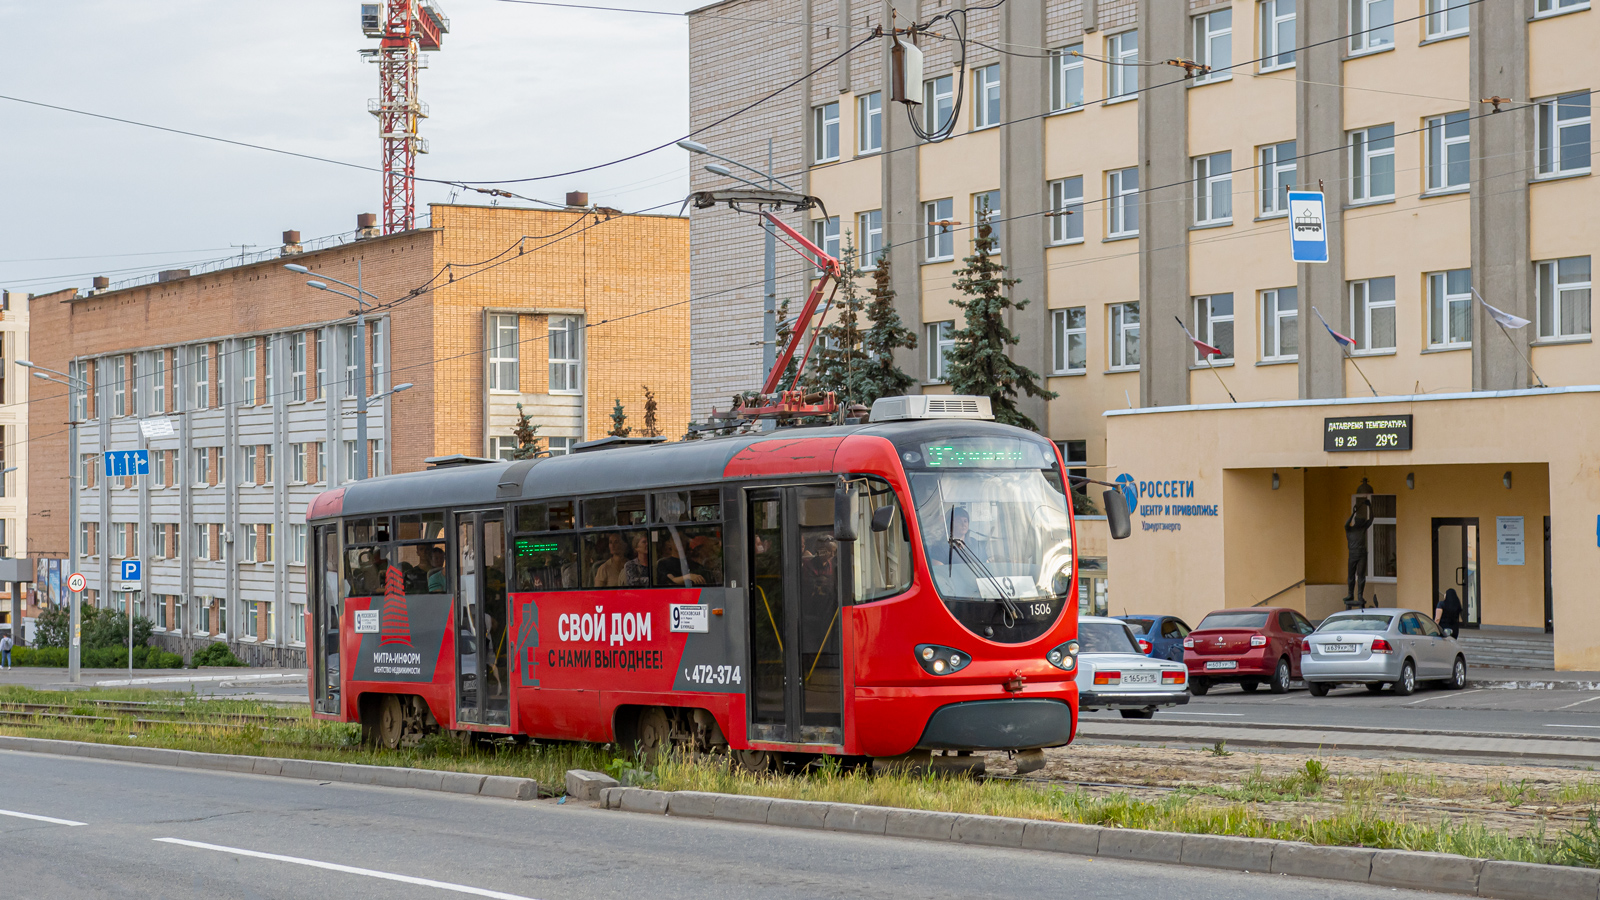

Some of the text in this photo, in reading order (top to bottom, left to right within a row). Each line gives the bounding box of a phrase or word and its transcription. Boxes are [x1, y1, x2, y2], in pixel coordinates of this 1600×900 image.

[1365, 420, 1406, 429] ТЕМПЕРАТУРА
[1335, 437, 1344, 447] 19
[1346, 436, 1357, 446] 25
[1140, 481, 1193, 498] РОССЕТИ
[1140, 505, 1218, 517] ЦЕНТР И ПРИВОЛЖЬЕ
[1142, 521, 1181, 532] Удмуртэнерго
[125, 563, 136, 578] P
[71, 578, 82, 586] 40
[1002, 577, 1015, 597] 9
[1030, 603, 1051, 615] 1506
[357, 613, 361, 630] 9
[673, 607, 680, 628] 9
[558, 605, 651, 646] СВОЙ ДОМ
[373, 652, 421, 664] МИТРА-ИНФОРМ
[548, 650, 663, 671] С НАМИ ВЫГОДНЕЕ!
[692, 665, 741, 684] 472-374
